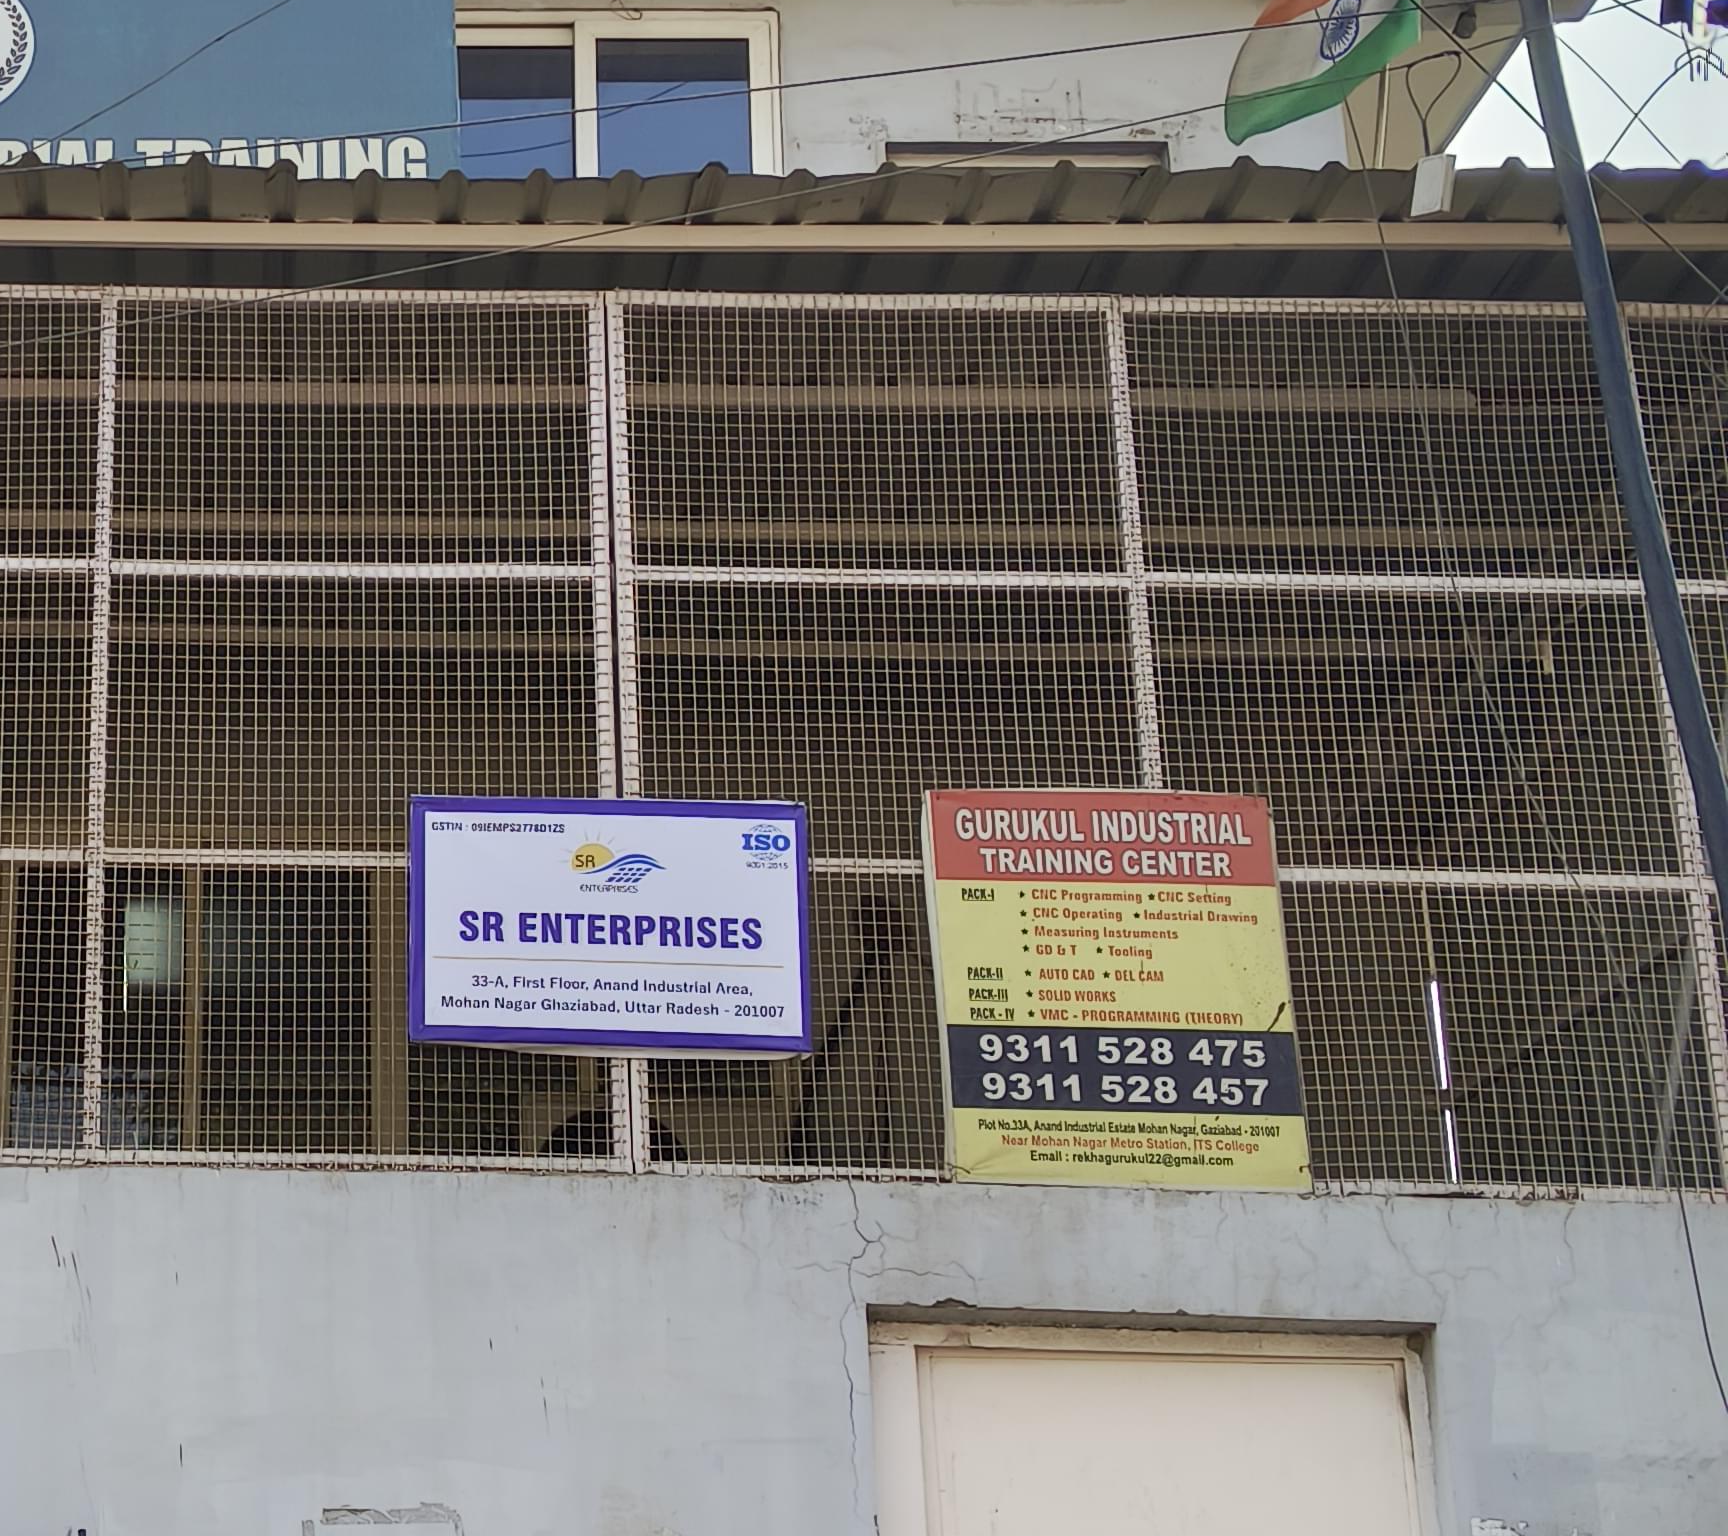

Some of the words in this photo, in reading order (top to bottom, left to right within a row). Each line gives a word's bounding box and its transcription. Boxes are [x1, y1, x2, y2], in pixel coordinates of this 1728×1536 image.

[432, 822, 463, 831] GSTIN
[955, 808, 1085, 842] GURUKUL
[1092, 810, 1252, 845] INDUSTRIAL
[742, 834, 790, 851] ISO
[575, 855, 595, 868] SR
[979, 847, 1113, 875] TRAINING
[1122, 849, 1232, 877] CENTER
[1031, 889, 1057, 900] CNC
[1061, 889, 1142, 904] Programming
[1158, 891, 1183, 903] CNC
[1187, 891, 1232, 906] Setting
[1033, 908, 1059, 919] CNC
[1062, 908, 1122, 922] Operating
[1144, 909, 1203, 921] Industrial
[1207, 911, 1258, 925] Drawing
[459, 910, 504, 942] SR
[519, 913, 763, 949] ENTERPRISES
[1034, 926, 1099, 940] Measuring
[1104, 927, 1178, 939] Instruments
[1036, 944, 1053, 956] GD
[1057, 945, 1066, 955] &
[1070, 945, 1077, 956] T
[1108, 946, 1152, 959] Tooling
[968, 967, 1003, 980] PACK-II
[1039, 969, 1069, 981] AUTO
[1073, 969, 1095, 981] CAD
[1115, 970, 1135, 981] DEL
[1139, 970, 1164, 982] CAM
[472, 975, 508, 988] 33-A,
[513, 976, 545, 989] First
[550, 977, 588, 990] Floor,
[593, 979, 638, 991] Anand
[643, 980, 711, 994] Industrial
[716, 982, 752, 996] Area,
[969, 988, 1008, 1001] PACK-III
[1038, 990, 1071, 1001] SOLID
[1075, 990, 1116, 1002] WORKS
[441, 995, 489, 1008] Mohan
[495, 997, 536, 1012] Nagar
[541, 998, 620, 1013] Ghaziabad,
[625, 1001, 661, 1013] Uttar
[734, 1004, 784, 1018] 201007
[971, 1007, 996, 1020] PACK
[1040, 1009, 1069, 1020] VMC
[1082, 1009, 1180, 1023] PROGRAMMING
[1185, 1011, 1243, 1026] (THEORY)
[979, 1034, 1078, 1064] 9311
[1098, 1037, 1173, 1065] 528
[1189, 1038, 1266, 1068] 475
[982, 1072, 1081, 1102] 9311
[1101, 1075, 1178, 1104] 528
[1193, 1078, 1269, 1106] 457
[978, 1119, 996, 1130] Plot
[1034, 1120, 1062, 1132] Anand
[1065, 1121, 1106, 1132] Industrial
[1138, 1123, 1167, 1134] Mohan
[1002, 1135, 1028, 1146] Near
[1032, 1135, 1070, 1147] Mohan
[1073, 1136, 1107, 1150] Nagar
[1111, 1138, 1143, 1149] Metro
[1146, 1138, 1191, 1151] Station,
[1216, 1140, 1259, 1154] College
[1030, 1150, 1062, 1162] Email
